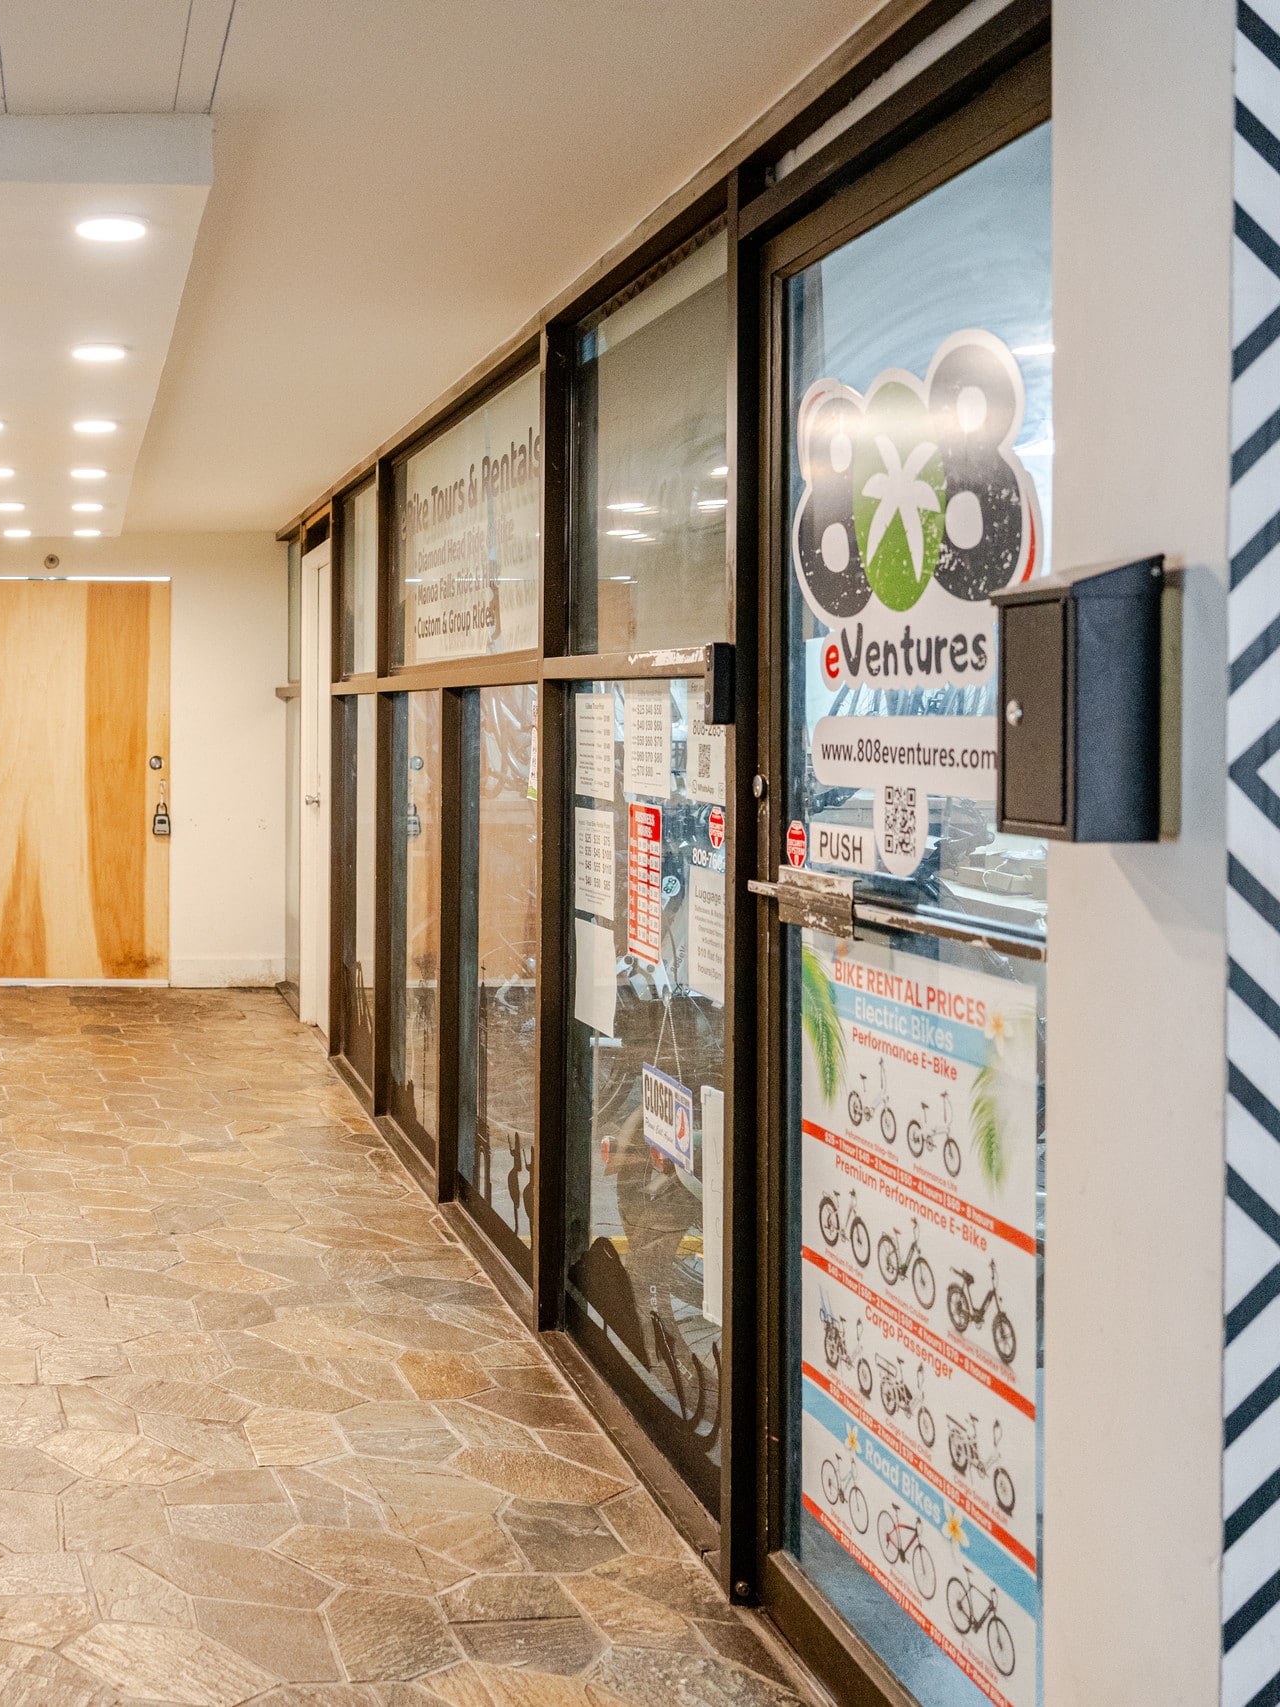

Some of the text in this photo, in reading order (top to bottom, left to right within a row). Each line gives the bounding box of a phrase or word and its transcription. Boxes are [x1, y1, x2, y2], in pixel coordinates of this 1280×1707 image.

[431, 477, 465, 526] Tours
[468, 463, 477, 509] &
[418, 583, 438, 606] Manoa
[440, 572, 455, 600] Falls
[457, 566, 473, 596] Ride
[418, 600, 495, 638] Custom & Group Rides
[825, 623, 988, 680] eVentures
[821, 736, 997, 771] www.808eventures.com
[820, 830, 863, 864] PUSH
[695, 885, 721, 906] Luggage
[835, 960, 986, 1028] BIKE RENTAL PRICES
[855, 997, 953, 1052] Electric Bikes
[852, 1027, 957, 1081] Performance E-Bike
[645, 1074, 673, 1126] CLOSED
[835, 1152, 986, 1251] Premium Performance E-Bike
[865, 1305, 954, 1380] Cargo Passenger
[865, 1439, 941, 1524] Road Bikes
